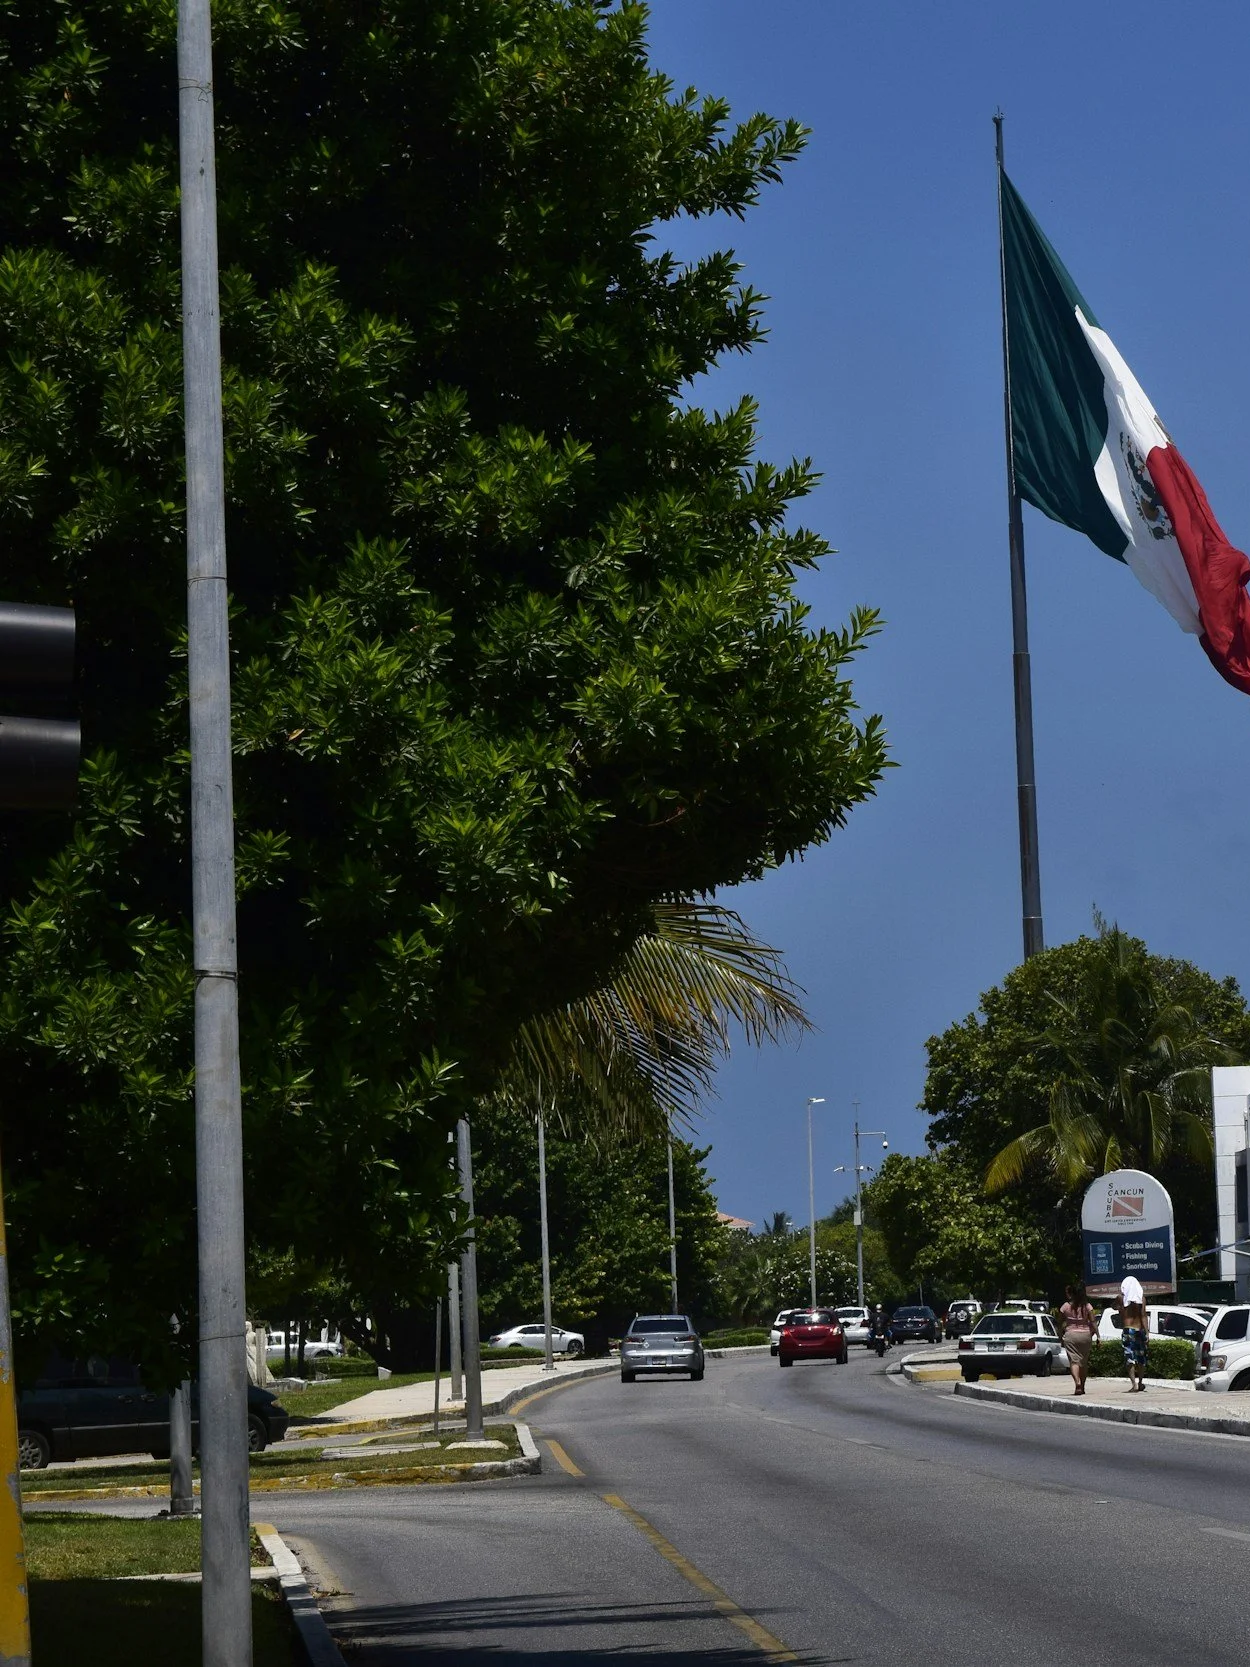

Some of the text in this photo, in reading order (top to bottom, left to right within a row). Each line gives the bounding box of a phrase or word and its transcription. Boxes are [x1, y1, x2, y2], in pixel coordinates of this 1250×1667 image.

[1145, 1241, 1164, 1249] Diving
[1126, 1252, 1147, 1260] Fishing
[1126, 1262, 1158, 1270] Snorkeling
